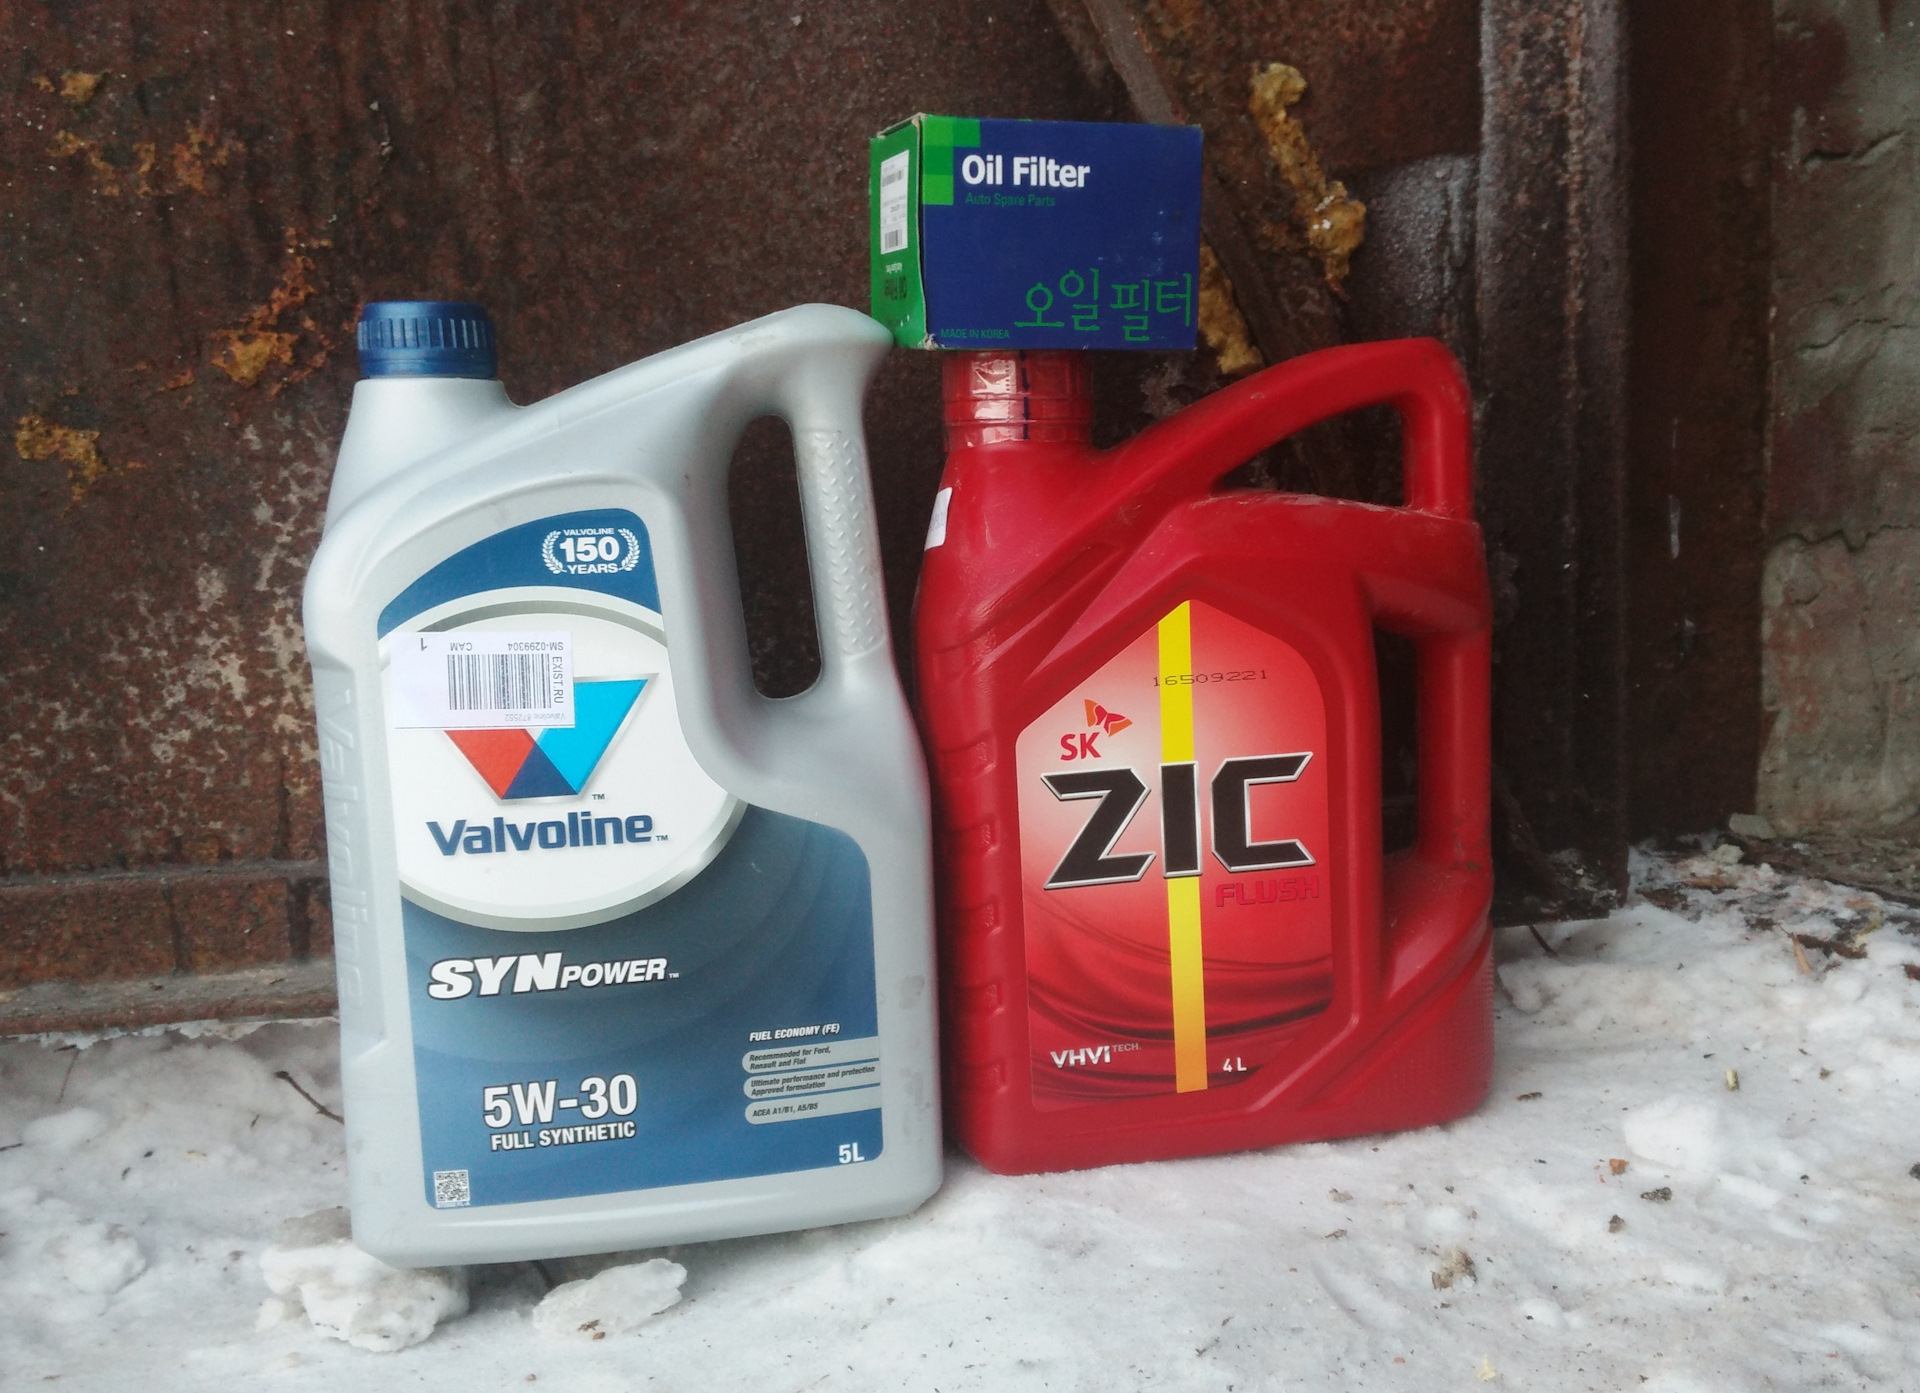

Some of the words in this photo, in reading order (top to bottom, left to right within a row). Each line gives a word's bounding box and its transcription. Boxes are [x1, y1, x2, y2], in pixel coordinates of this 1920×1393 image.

[962, 155, 1002, 185] Oil
[1013, 156, 1090, 187] Filter
[966, 193, 990, 205] Auto
[994, 194, 1024, 208] Spare
[1028, 194, 1055, 206] Parts
[941, 329, 967, 338] MADE
[970, 329, 978, 338] IN
[981, 329, 1010, 338] KOREA
[563, 528, 615, 536] VALVOLINE
[560, 536, 619, 562] 150
[567, 563, 618, 574] YEARS
[420, 637, 428, 652] 1
[450, 642, 473, 651] CAM
[507, 642, 564, 651] SM-0299304
[552, 656, 564, 704] EXIST.RU
[1152, 670, 1267, 687] 16509221
[1060, 731, 1101, 761] SK
[1040, 751, 1316, 890] ZIC
[426, 811, 653, 856] Valvoline
[1215, 876, 1319, 907] FLUSH
[749, 1031, 772, 1042] FUEL
[774, 1025, 820, 1038] ECONOMY
[822, 1023, 840, 1036] (FE)
[749, 1050, 800, 1062] Recommended
[802, 1048, 812, 1056] for
[814, 1046, 831, 1055] Ford,
[750, 1060, 776, 1070] Renault
[793, 1057, 806, 1065] Fiat
[751, 1076, 780, 1087] Ultimate
[781, 1072, 825, 1085] performance
[827, 1070, 840, 1078] and
[841, 1065, 876, 1077] protection
[751, 1085, 784, 1096] Approved
[786, 1081, 826, 1092] formulation
[483, 1074, 637, 1128] 5W-30
[752, 1107, 771, 1117] ACEA
[490, 1131, 535, 1150] FULL
[538, 1121, 636, 1147] SYNTHETIC
[838, 1142, 865, 1164] 5L
